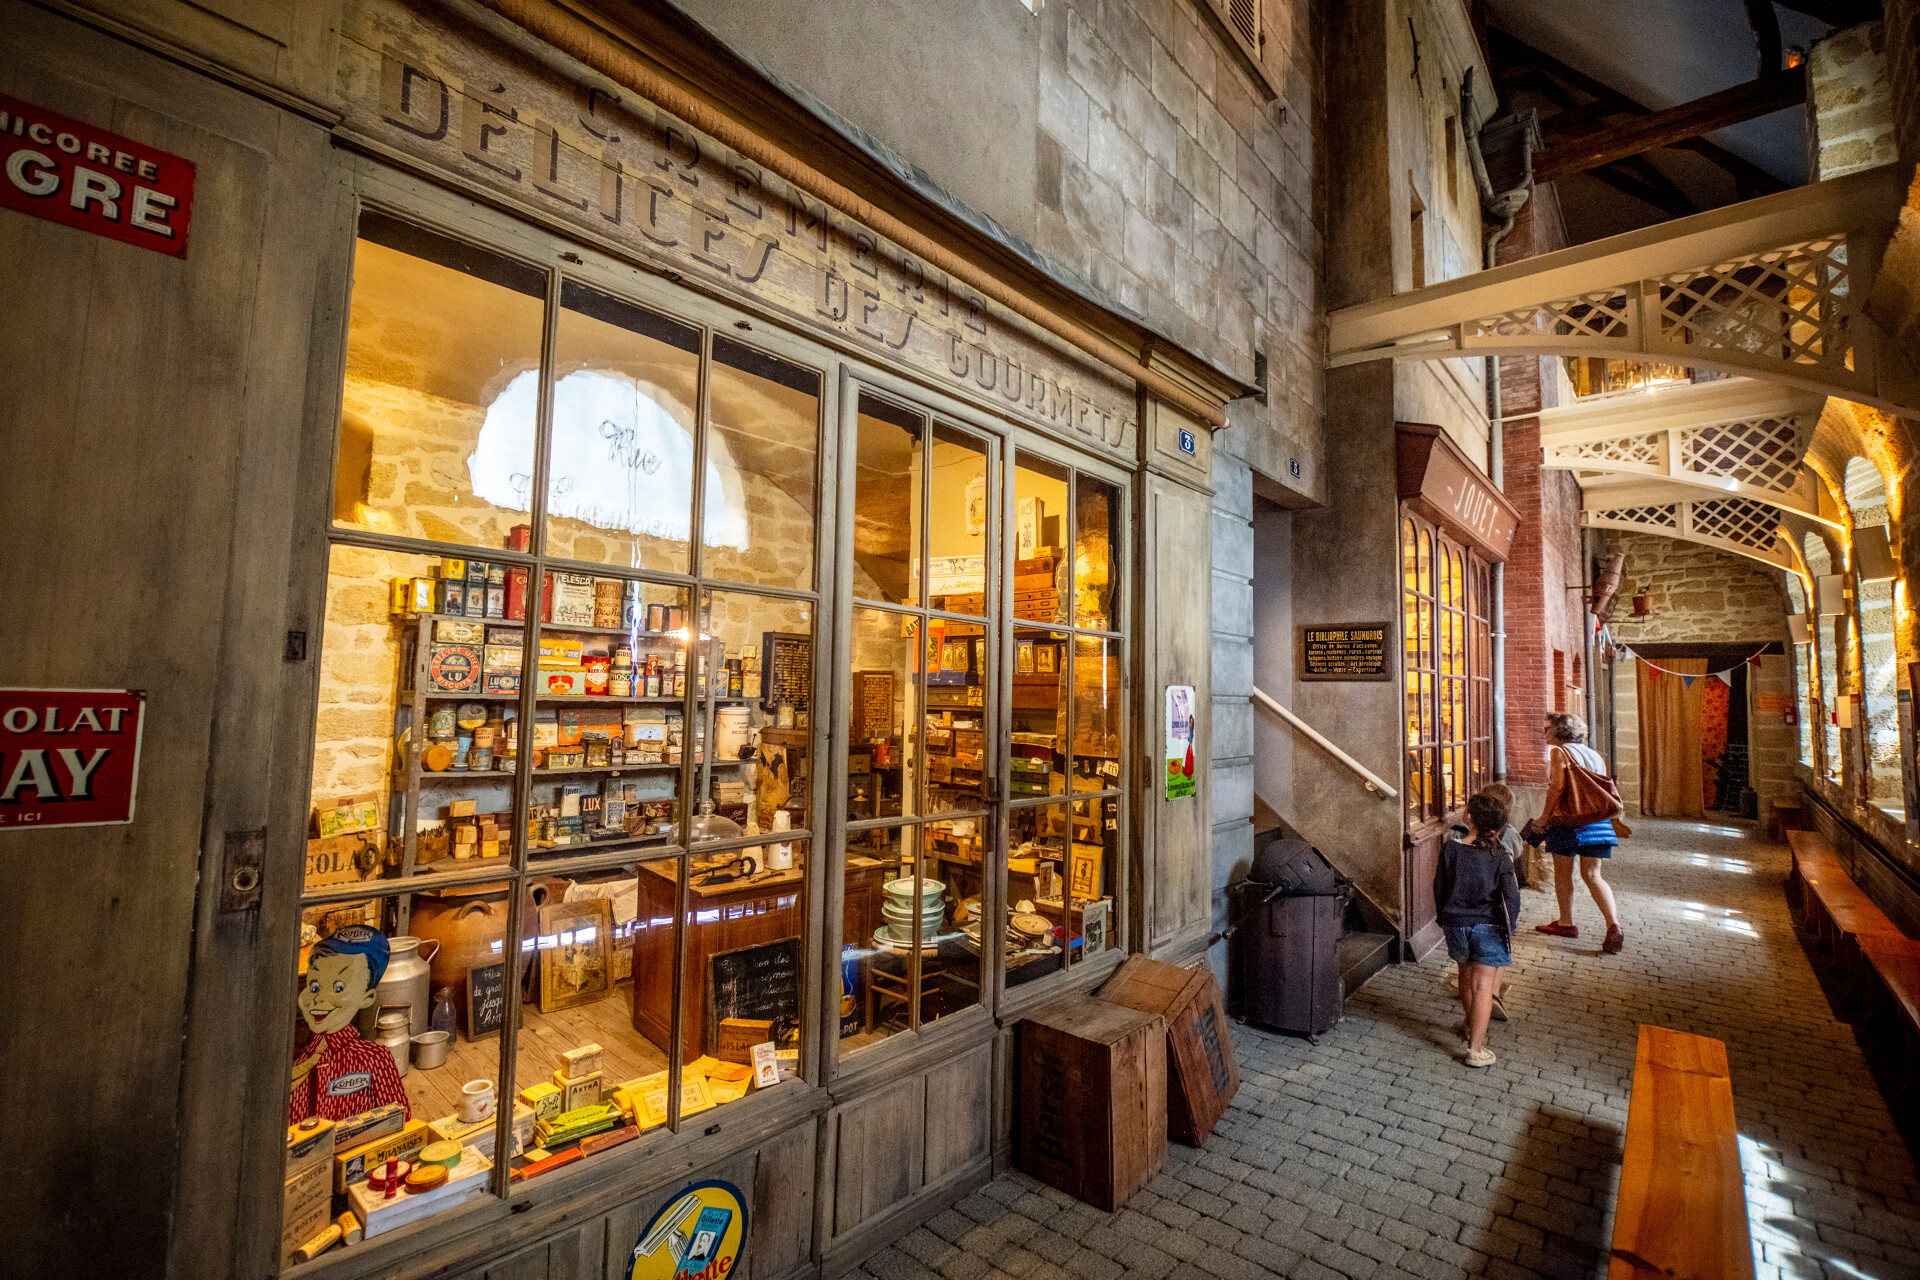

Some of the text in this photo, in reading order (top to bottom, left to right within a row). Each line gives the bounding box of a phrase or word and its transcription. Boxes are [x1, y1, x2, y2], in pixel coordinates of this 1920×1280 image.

[814, 255, 919, 350] DES
[943, 326, 1131, 450] GOURMETS
[1184, 434, 1192, 450] 3
[1454, 476, 1499, 540] JOUET
[1307, 629, 1383, 642] LE BIBLIOPHILE SAUMUROIS
[448, 672, 463, 681] LU
[3, 706, 129, 734] OLAT
[583, 797, 601, 812] LUX
[18, 812, 42, 822] ICI
[701, 1214, 724, 1225] Gillette
[308, 1228, 332, 1246] COCO
